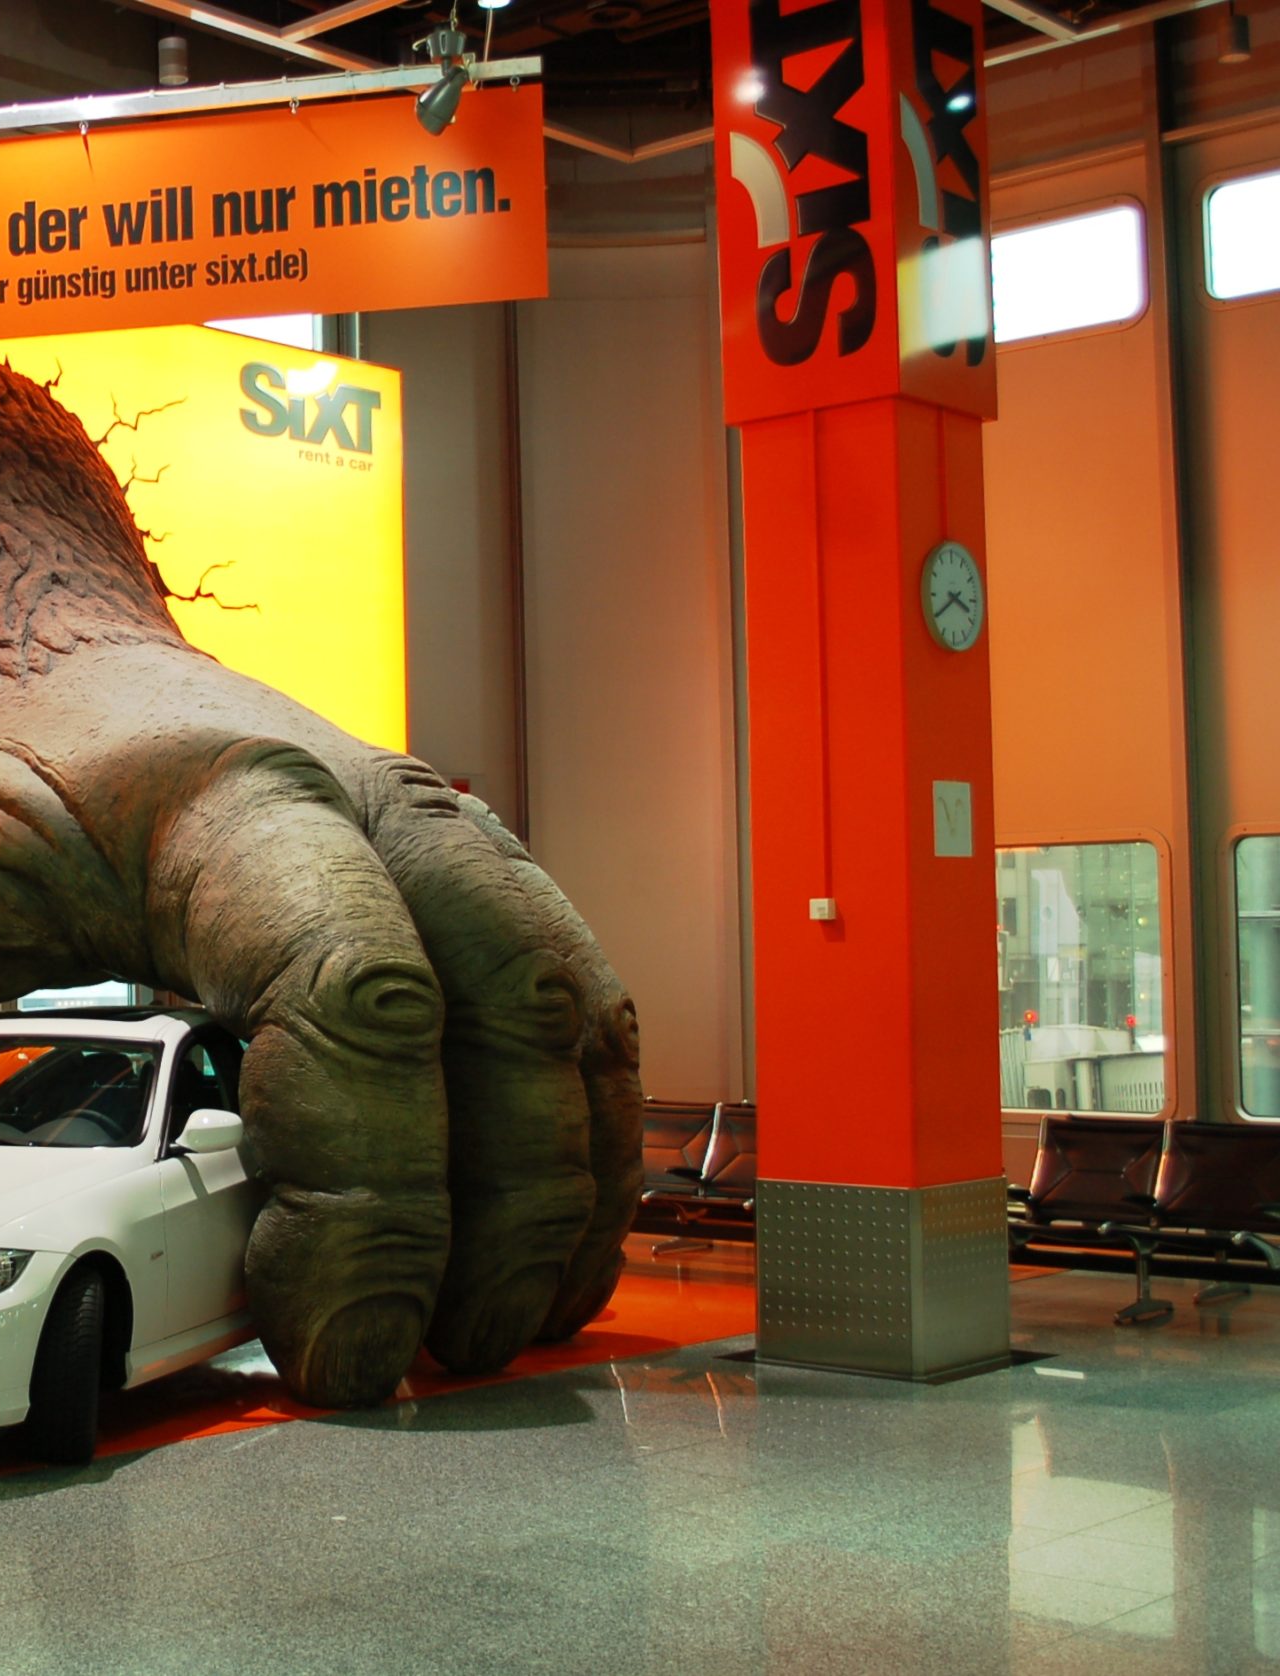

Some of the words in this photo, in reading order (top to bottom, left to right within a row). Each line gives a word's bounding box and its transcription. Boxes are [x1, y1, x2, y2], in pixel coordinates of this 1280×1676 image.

[9, 201, 87, 255] der
[103, 186, 193, 246] will
[212, 186, 296, 237] nur
[313, 165, 512, 228] mieten.
[18, 266, 117, 305] günstig
[125, 261, 197, 292] unter
[206, 249, 308, 287] sixt.de)
[298, 449, 330, 465] rent
[335, 454, 344, 467] a
[349, 460, 373, 472] car
